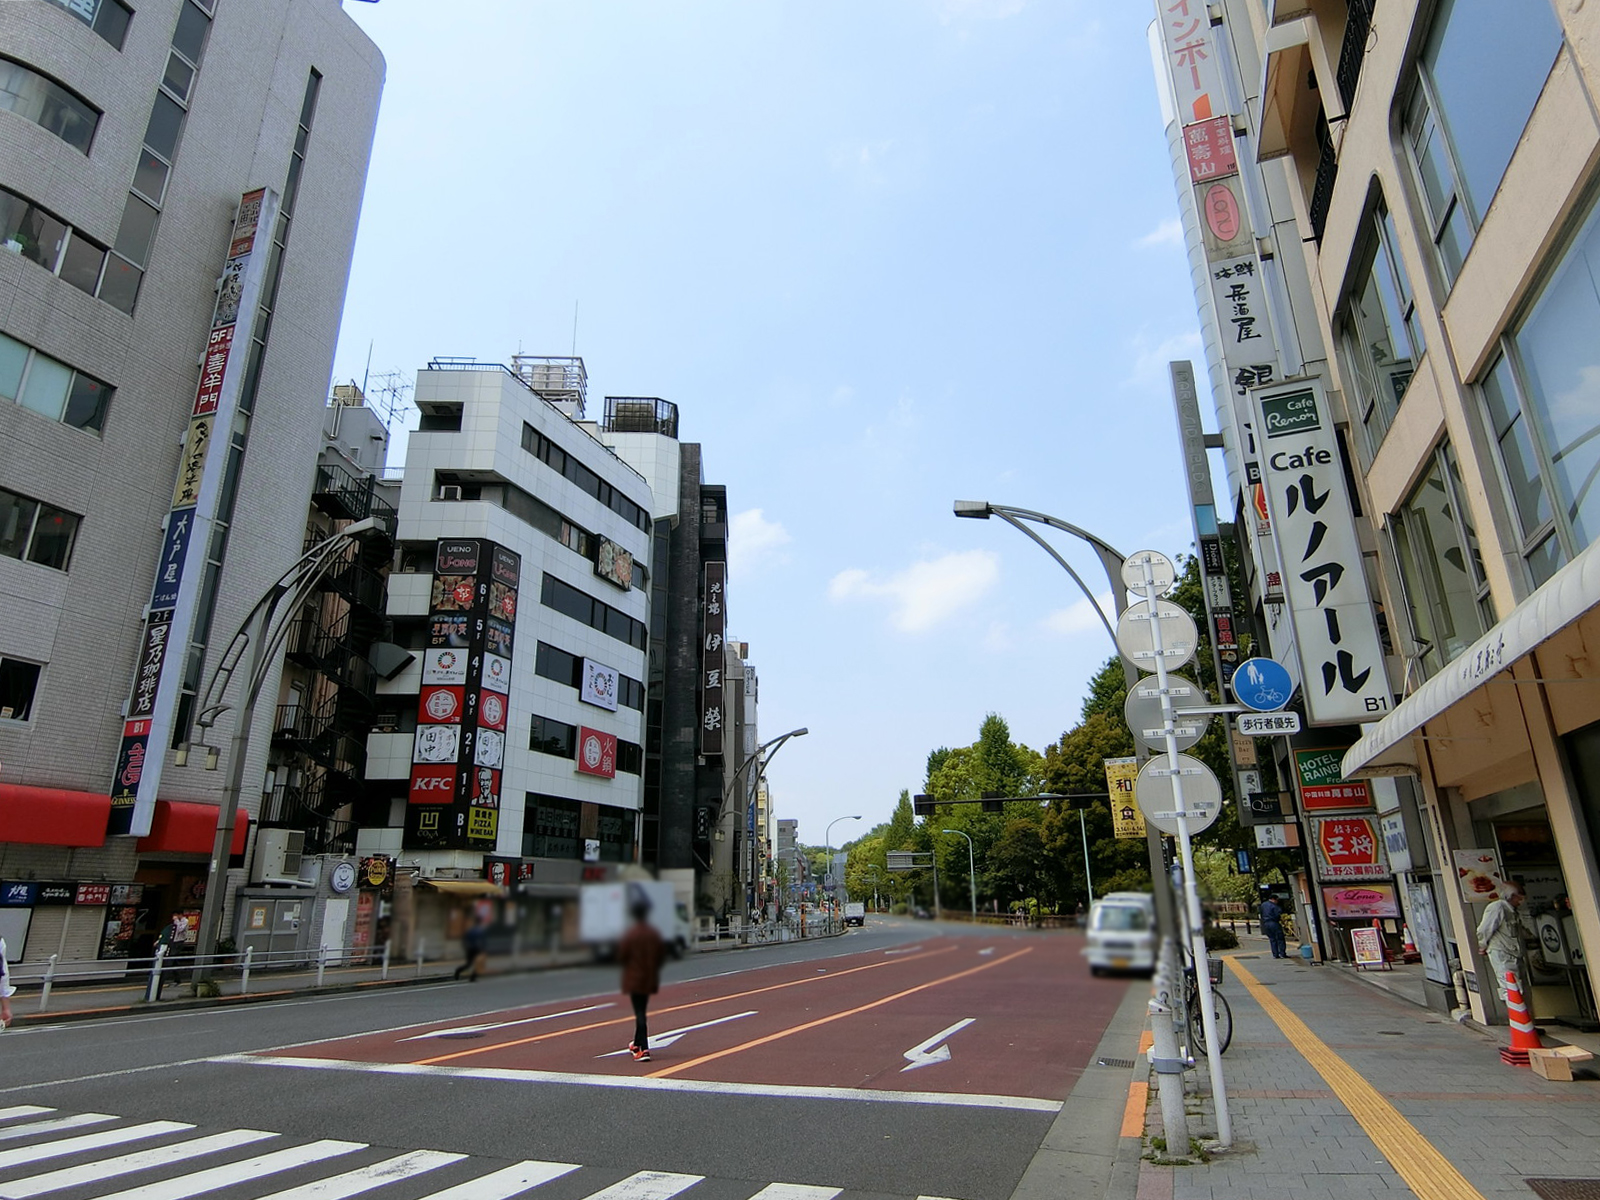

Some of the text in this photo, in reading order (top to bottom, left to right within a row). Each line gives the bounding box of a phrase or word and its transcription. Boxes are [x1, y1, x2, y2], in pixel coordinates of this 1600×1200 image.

[1213, 119, 1232, 156] 中国料理
[1214, 261, 1255, 281] 海鮮
[1224, 283, 1262, 343] 居酒屋
[211, 329, 227, 343] 5F
[197, 353, 227, 414] 喜羊門
[1287, 397, 1314, 411] Cafe
[1267, 408, 1317, 429] Renoir
[1176, 371, 1207, 492] PARK SIDE BLDG
[1270, 445, 1331, 471] Cafe
[164, 514, 188, 583] 大戸屋
[498, 553, 515, 566] UENO
[1286, 473, 1372, 696] ルノアール
[154, 611, 170, 622] 2F
[431, 637, 446, 645] 5F
[487, 641, 497, 650] 5F
[134, 624, 168, 714] 星乃珈琲店
[1364, 696, 1388, 712] B1
[133, 721, 144, 733] B1
[1243, 717, 1296, 731] 歩行者優先
[424, 732, 437, 756] 田中
[602, 737, 613, 773] 火鍋
[1299, 753, 1338, 772] HOTEL
[121, 742, 145, 786] HUB
[413, 777, 452, 790] KFC
[1116, 778, 1133, 792] 和
[470, 828, 494, 836] WINE BAR
[473, 819, 492, 829] PIZZA
[1333, 824, 1361, 834] 餃子の
[1326, 834, 1373, 856] 王将
[1324, 865, 1384, 876] 上野公園前店
